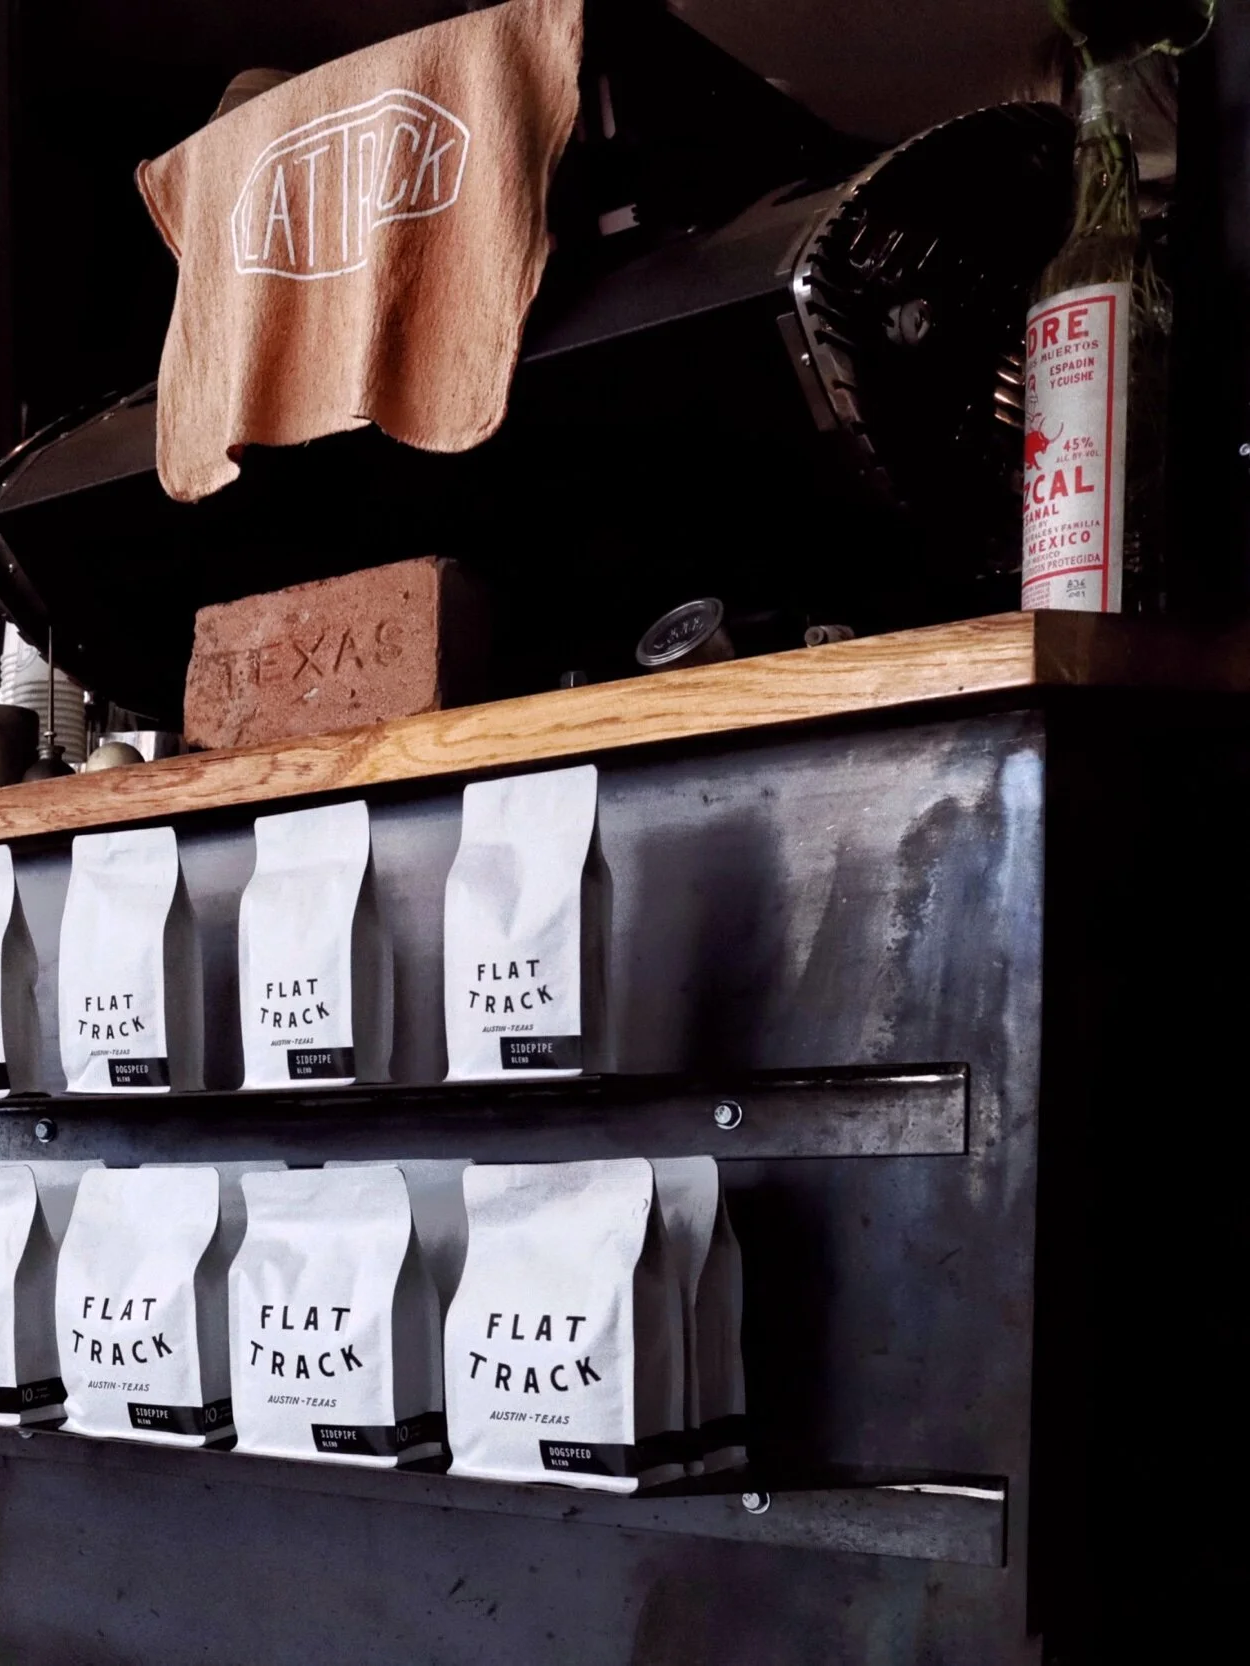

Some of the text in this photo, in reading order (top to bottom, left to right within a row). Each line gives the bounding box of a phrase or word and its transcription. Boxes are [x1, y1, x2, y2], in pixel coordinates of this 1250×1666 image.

[1028, 308, 1089, 358] DRE
[1040, 339, 1100, 365] MUERTOS
[1050, 356, 1095, 377] ESPADIN
[1056, 370, 1095, 388] CUISHE
[1063, 436, 1094, 452] 45%
[1085, 449, 1102, 458] VOL.
[1061, 520, 1101, 531] FAMILIA
[1028, 530, 1091, 556] MEXICO
[1047, 553, 1101, 571] PROTEGIDA
[195, 618, 404, 696] TEXAS
[477, 959, 540, 981] FLAT
[266, 978, 318, 999] FLAT
[468, 984, 554, 1013] TRACK
[84, 994, 134, 1012] FLAT
[258, 1001, 330, 1029] TRACK
[78, 1015, 145, 1040] TRACK
[510, 1042, 554, 1054] SIDEPIPE
[115, 1064, 149, 1075] DOGSPEED
[295, 1054, 332, 1065] SIDEPIPE
[82, 1296, 157, 1321] FLAT
[260, 1304, 351, 1333] FLAT
[486, 1312, 586, 1343] FLAT
[71, 1329, 173, 1366] TRACK
[249, 1340, 364, 1380] TRACK
[466, 1350, 602, 1396] TRACK
[21, 1387, 34, 1404] 10
[135, 1407, 169, 1420] SIDEPIPE
[205, 1406, 217, 1424] 10
[320, 1428, 357, 1442] SIDEPIPE
[548, 1445, 592, 1460] DOGSPEED
